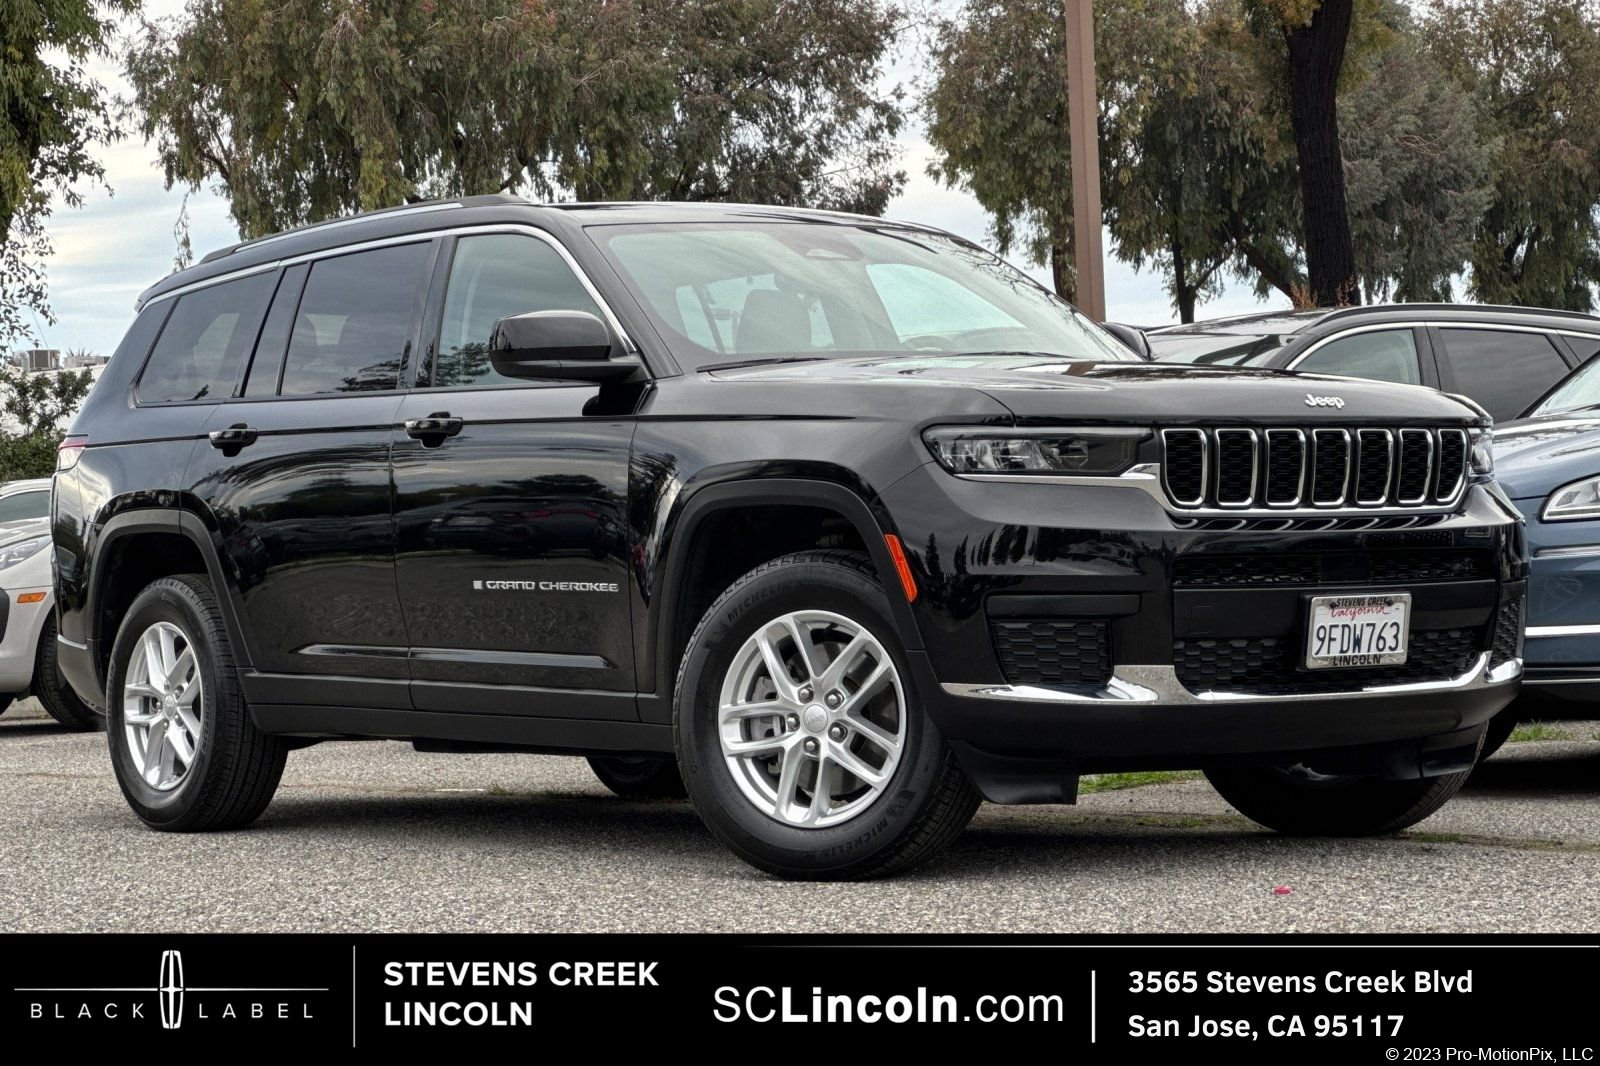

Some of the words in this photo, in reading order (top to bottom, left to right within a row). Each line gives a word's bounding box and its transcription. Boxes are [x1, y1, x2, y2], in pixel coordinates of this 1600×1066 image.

[1304, 394, 1345, 409] Jeep
[485, 580, 536, 590] GRAND
[539, 581, 620, 592] CHEROKEE
[1336, 598, 1366, 608] STEVENS
[1331, 606, 1391, 621] California
[1315, 621, 1401, 656] 9FDW763
[1333, 654, 1382, 666] LINCOLN
